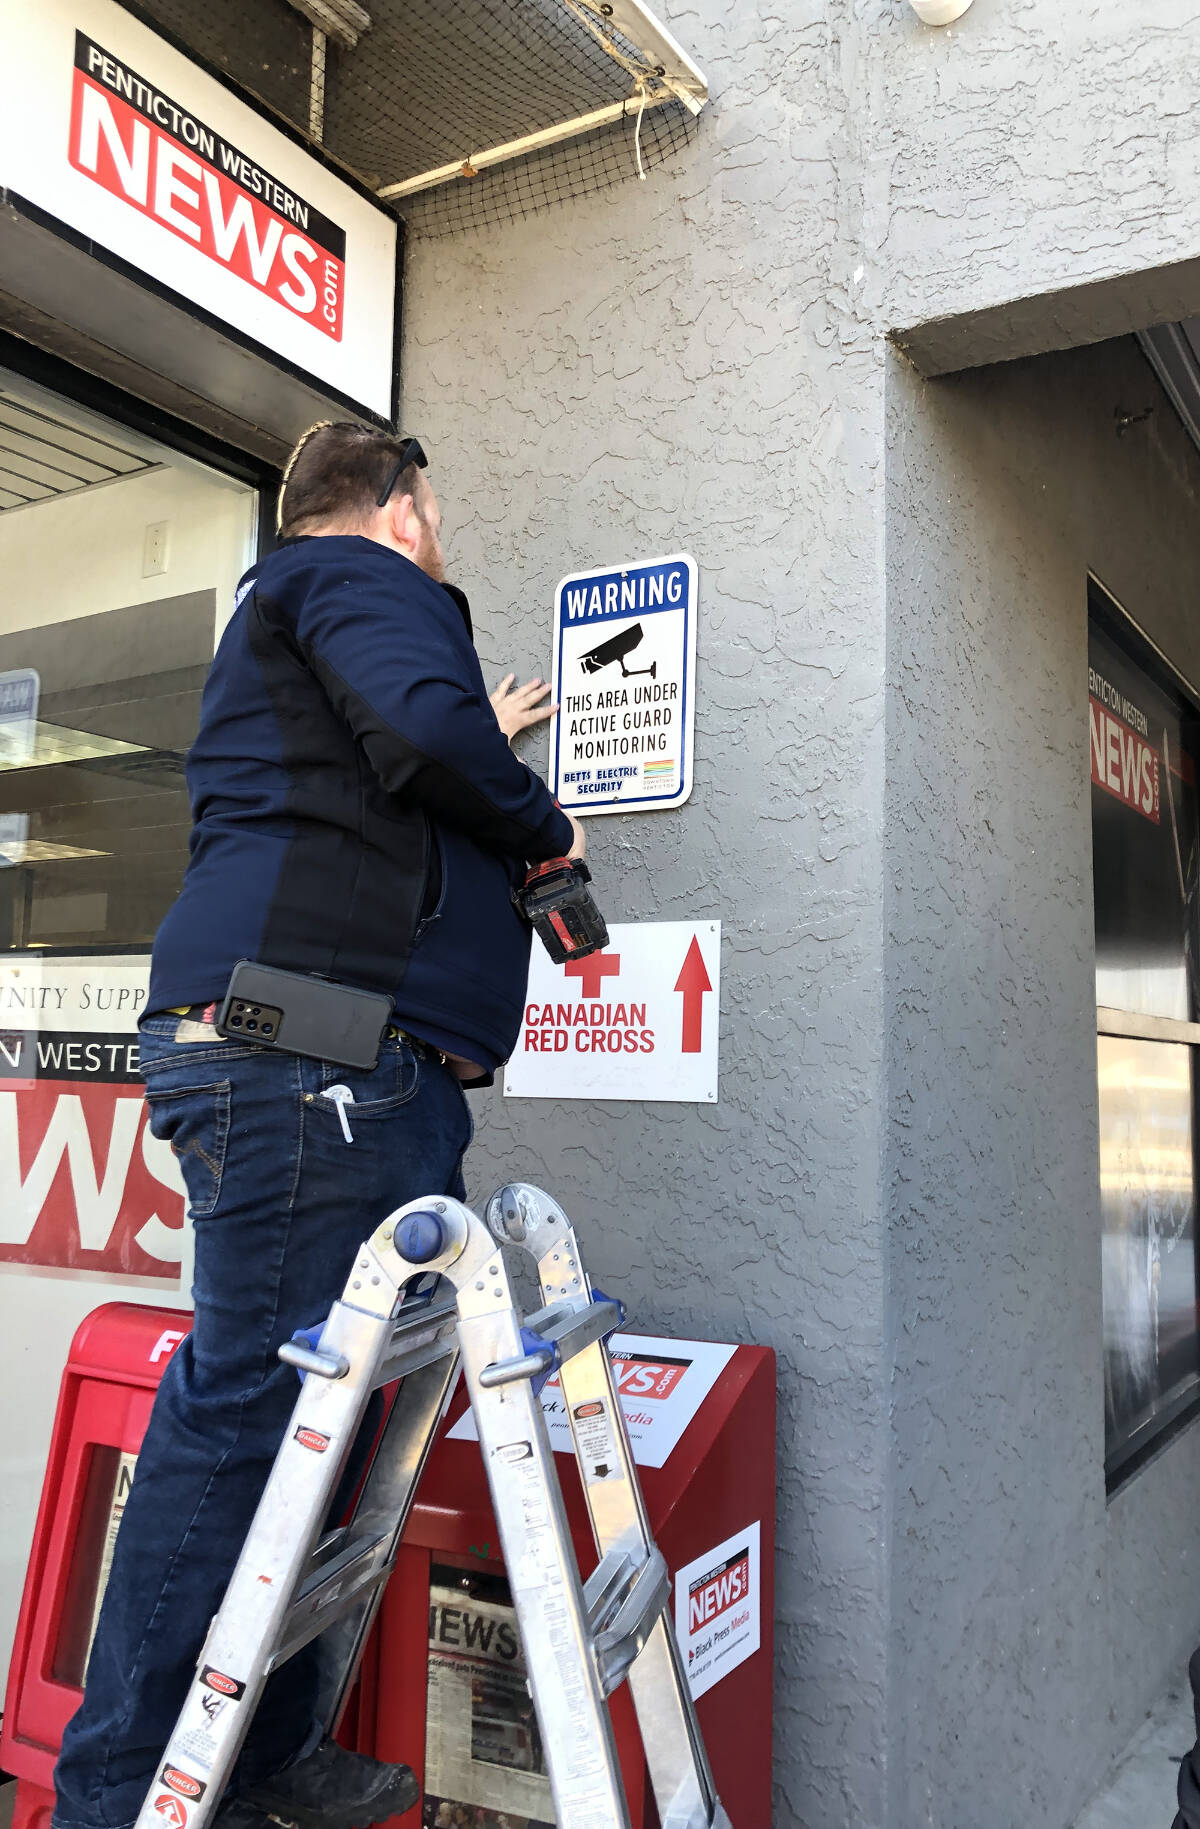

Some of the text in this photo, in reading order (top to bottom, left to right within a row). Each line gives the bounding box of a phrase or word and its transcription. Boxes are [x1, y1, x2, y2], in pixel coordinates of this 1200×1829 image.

[88, 45, 309, 230] PENTICTON WESTERN
[79, 82, 318, 314] NEWS
[322, 259, 338, 332] .com
[567, 571, 682, 620] WARNING
[566, 682, 678, 713] THIS AREA UNDER
[570, 708, 672, 736] ACTIVE GUARD
[1122, 696, 1148, 736] WESTERN
[574, 733, 667, 760] MONITORING
[1089, 702, 1153, 815] NEWS
[564, 767, 638, 783] BETTS ELECTRIC
[577, 781, 623, 794] SECURITY
[0, 985, 68, 1009] NITY
[525, 1003, 647, 1027] CANADIAN
[524, 1029, 655, 1053] RED CROSS
[610, 1351, 634, 1360] TERN
[656, 1369, 678, 1396] .com
[689, 1565, 742, 1631] NEWS
[695, 1636, 713, 1660] Black
[714, 1626, 730, 1645] Press
[731, 1610, 750, 1631] Media
[167, 1772, 197, 1792] DANGER
